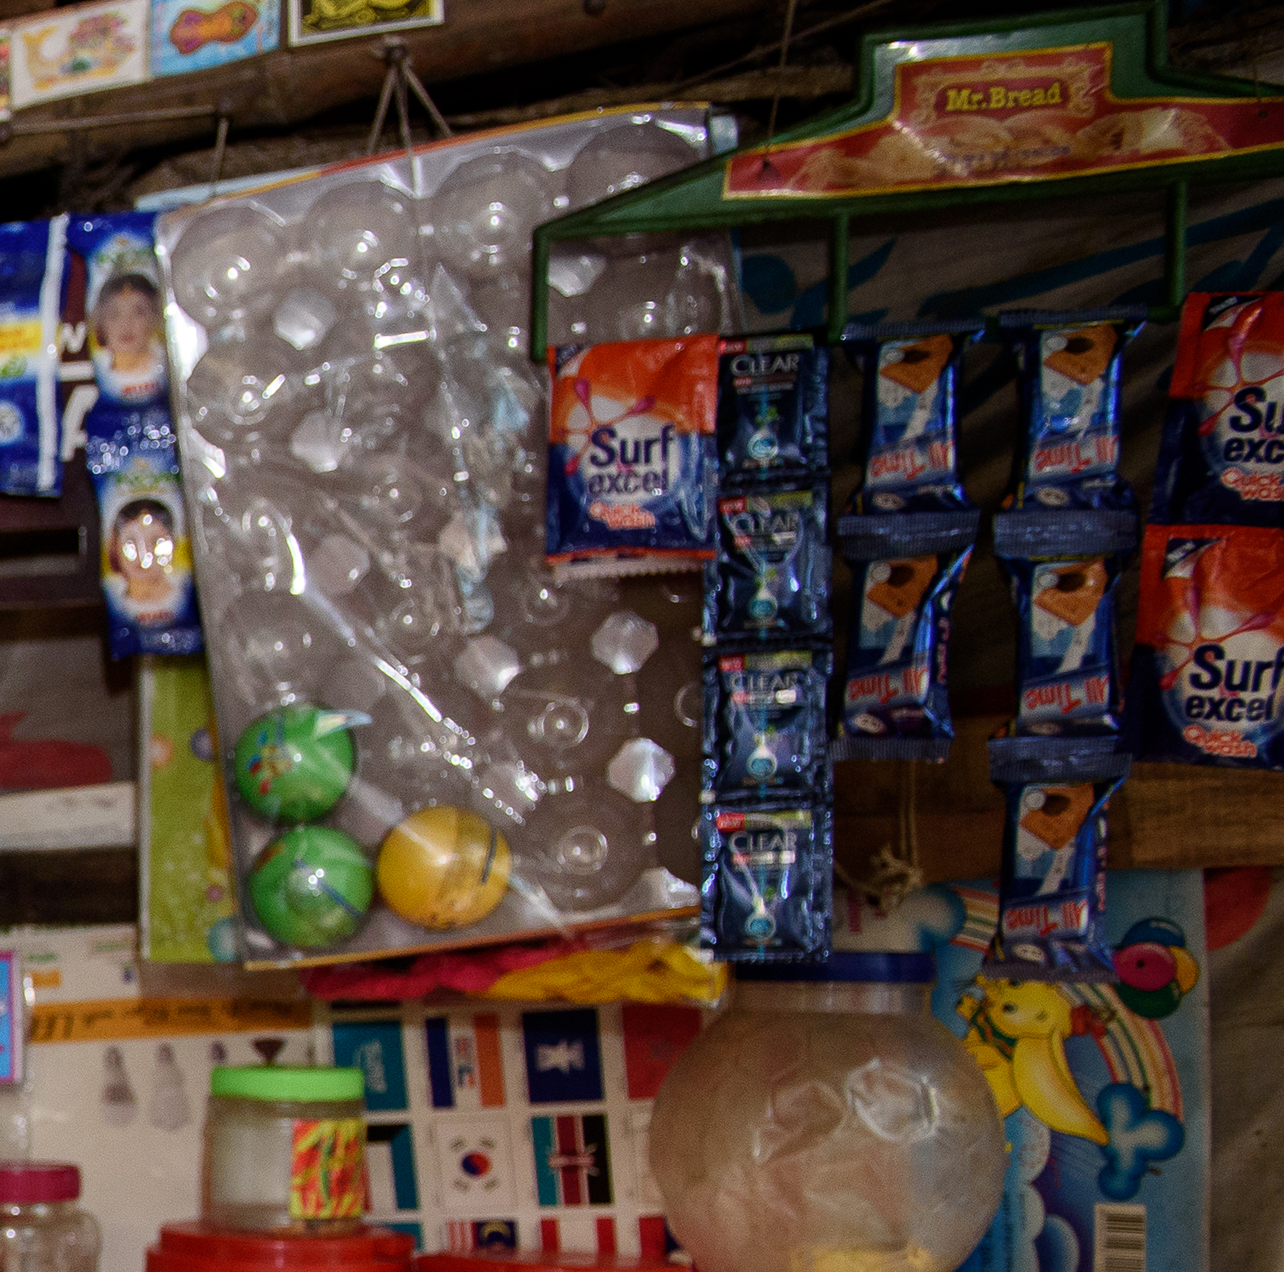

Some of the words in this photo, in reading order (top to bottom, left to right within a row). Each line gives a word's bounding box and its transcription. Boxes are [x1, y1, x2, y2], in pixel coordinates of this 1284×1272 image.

[732, 353, 800, 375] CLEAR
[1229, 387, 1284, 432] Su
[590, 423, 675, 467] Surf
[1035, 443, 1091, 475] Time
[1223, 437, 1284, 463] exc
[588, 467, 669, 495] excel
[870, 450, 926, 481] Time
[1239, 484, 1284, 501] was
[1189, 643, 1284, 692] Surf
[847, 674, 899, 704] Time
[1023, 682, 1081, 714] Time
[1185, 690, 1276, 722] excel
[729, 830, 798, 851] CLEAR
[1006, 905, 1058, 936] Time
